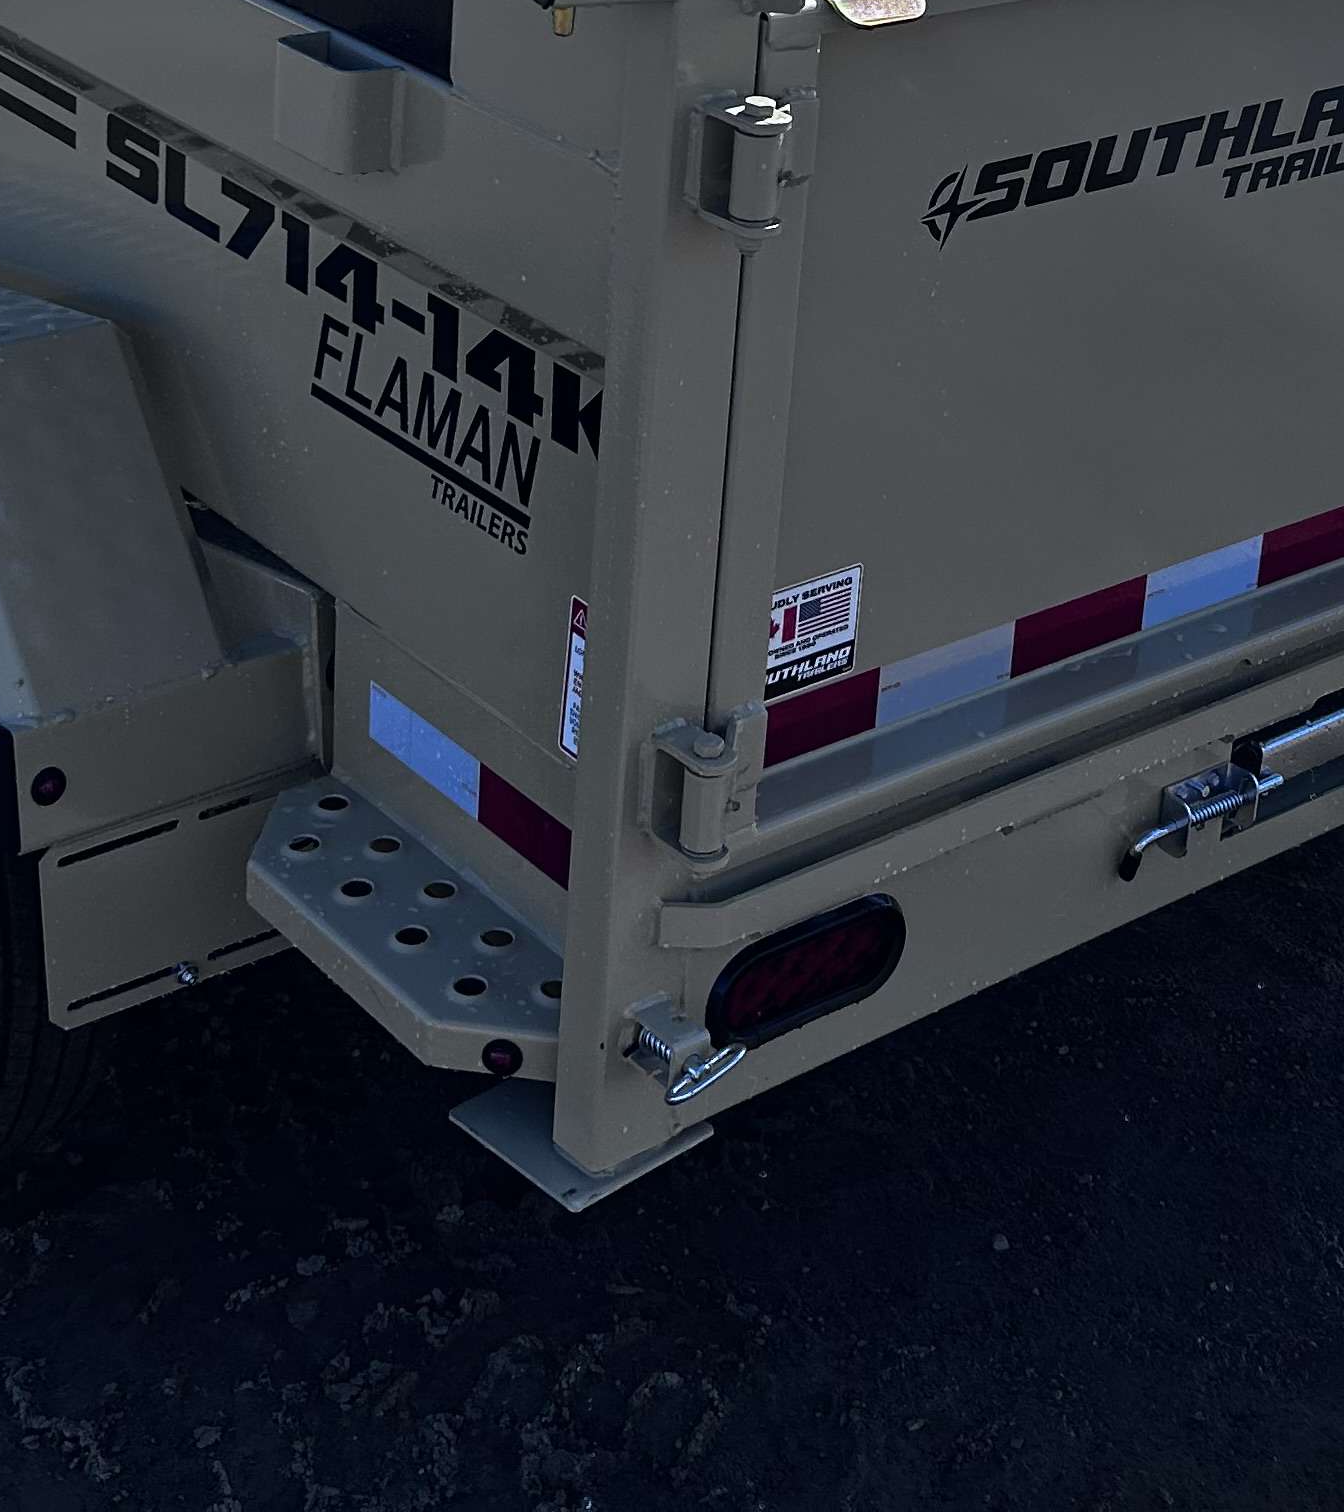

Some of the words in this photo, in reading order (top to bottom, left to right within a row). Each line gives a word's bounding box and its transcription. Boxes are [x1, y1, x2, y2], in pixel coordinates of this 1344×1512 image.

[106, 112, 604, 461] SL714-14K
[314, 312, 541, 508] FLAMAN
[429, 474, 527, 555] TRAILERS
[771, 593, 800, 610] UDLY
[802, 577, 853, 600] SERVING
[767, 645, 852, 685] UTHLAND
